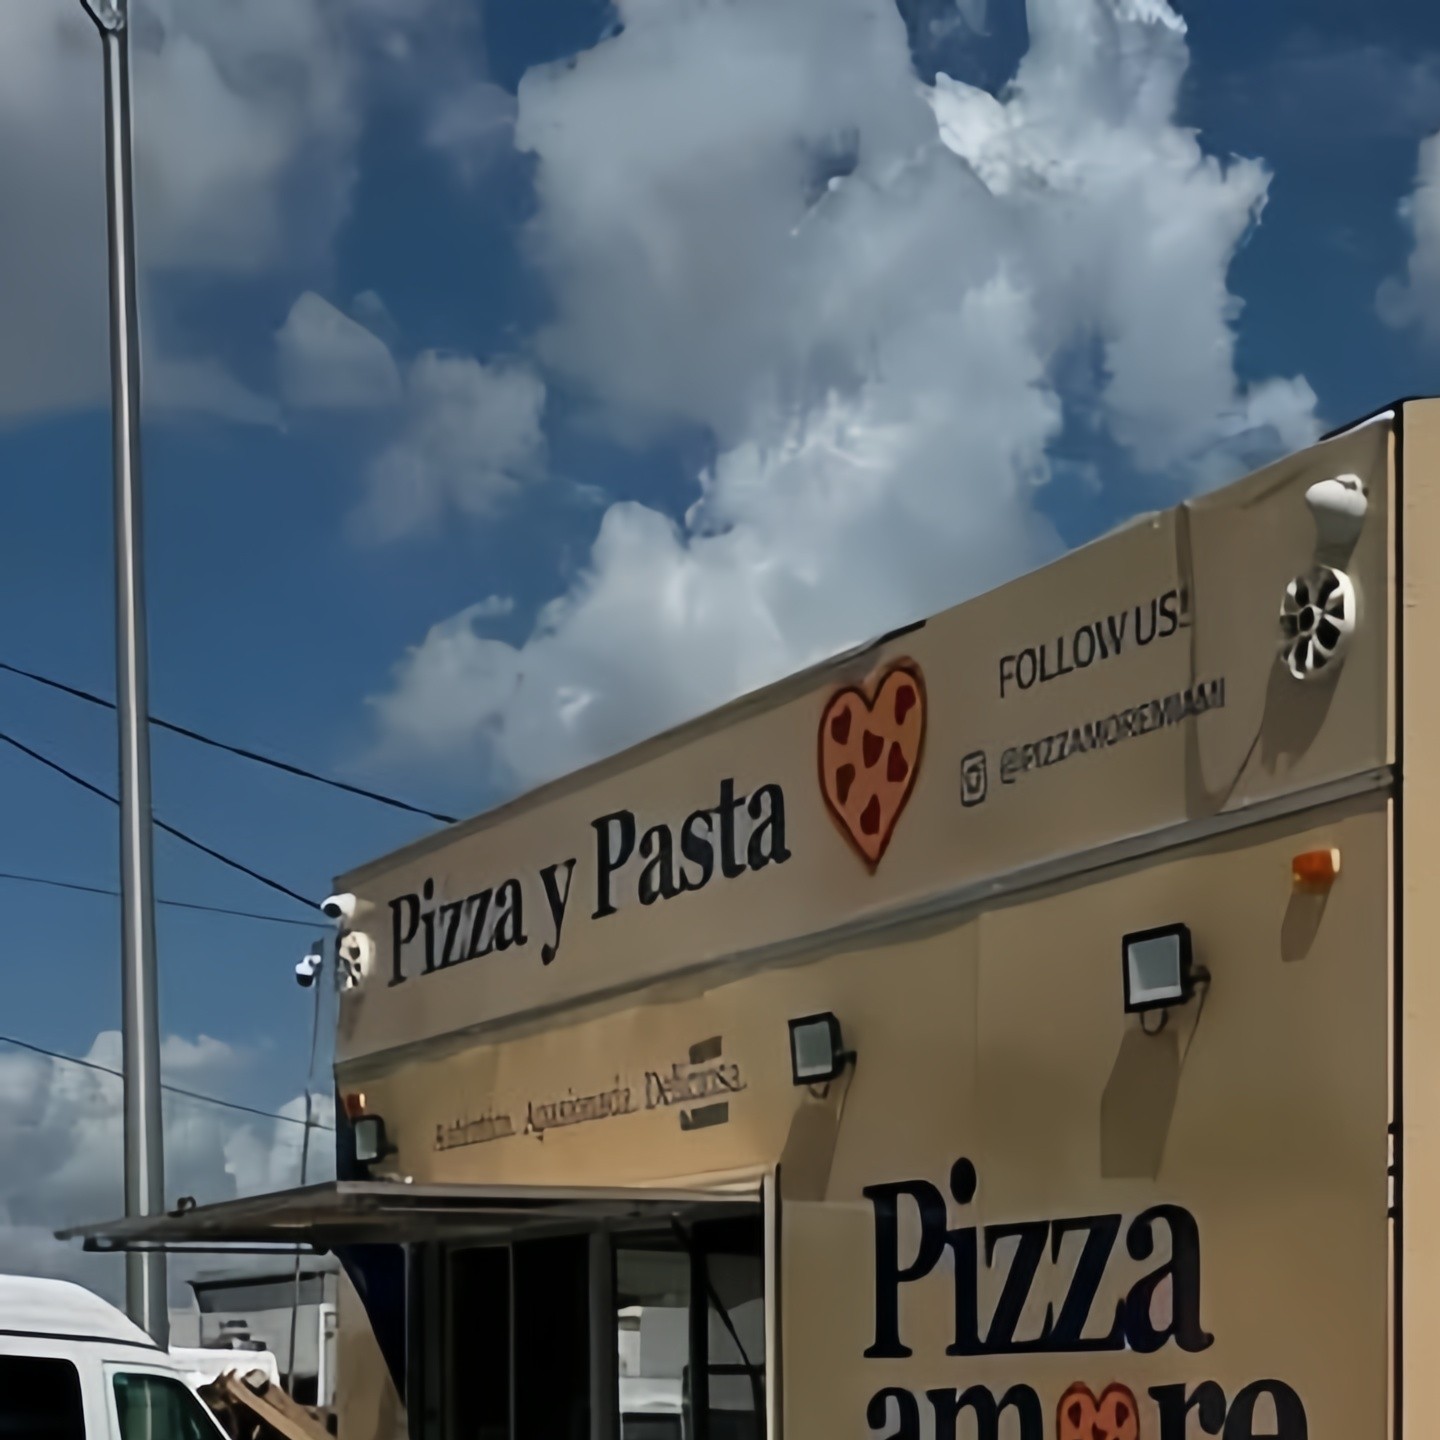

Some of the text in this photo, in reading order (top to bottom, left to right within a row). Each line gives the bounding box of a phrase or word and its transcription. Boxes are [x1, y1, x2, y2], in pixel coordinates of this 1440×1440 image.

[999, 611, 1127, 698] FOLLOW
[388, 777, 791, 987] Pizza y Pasta
[863, 1157, 1215, 1358] Pizza
